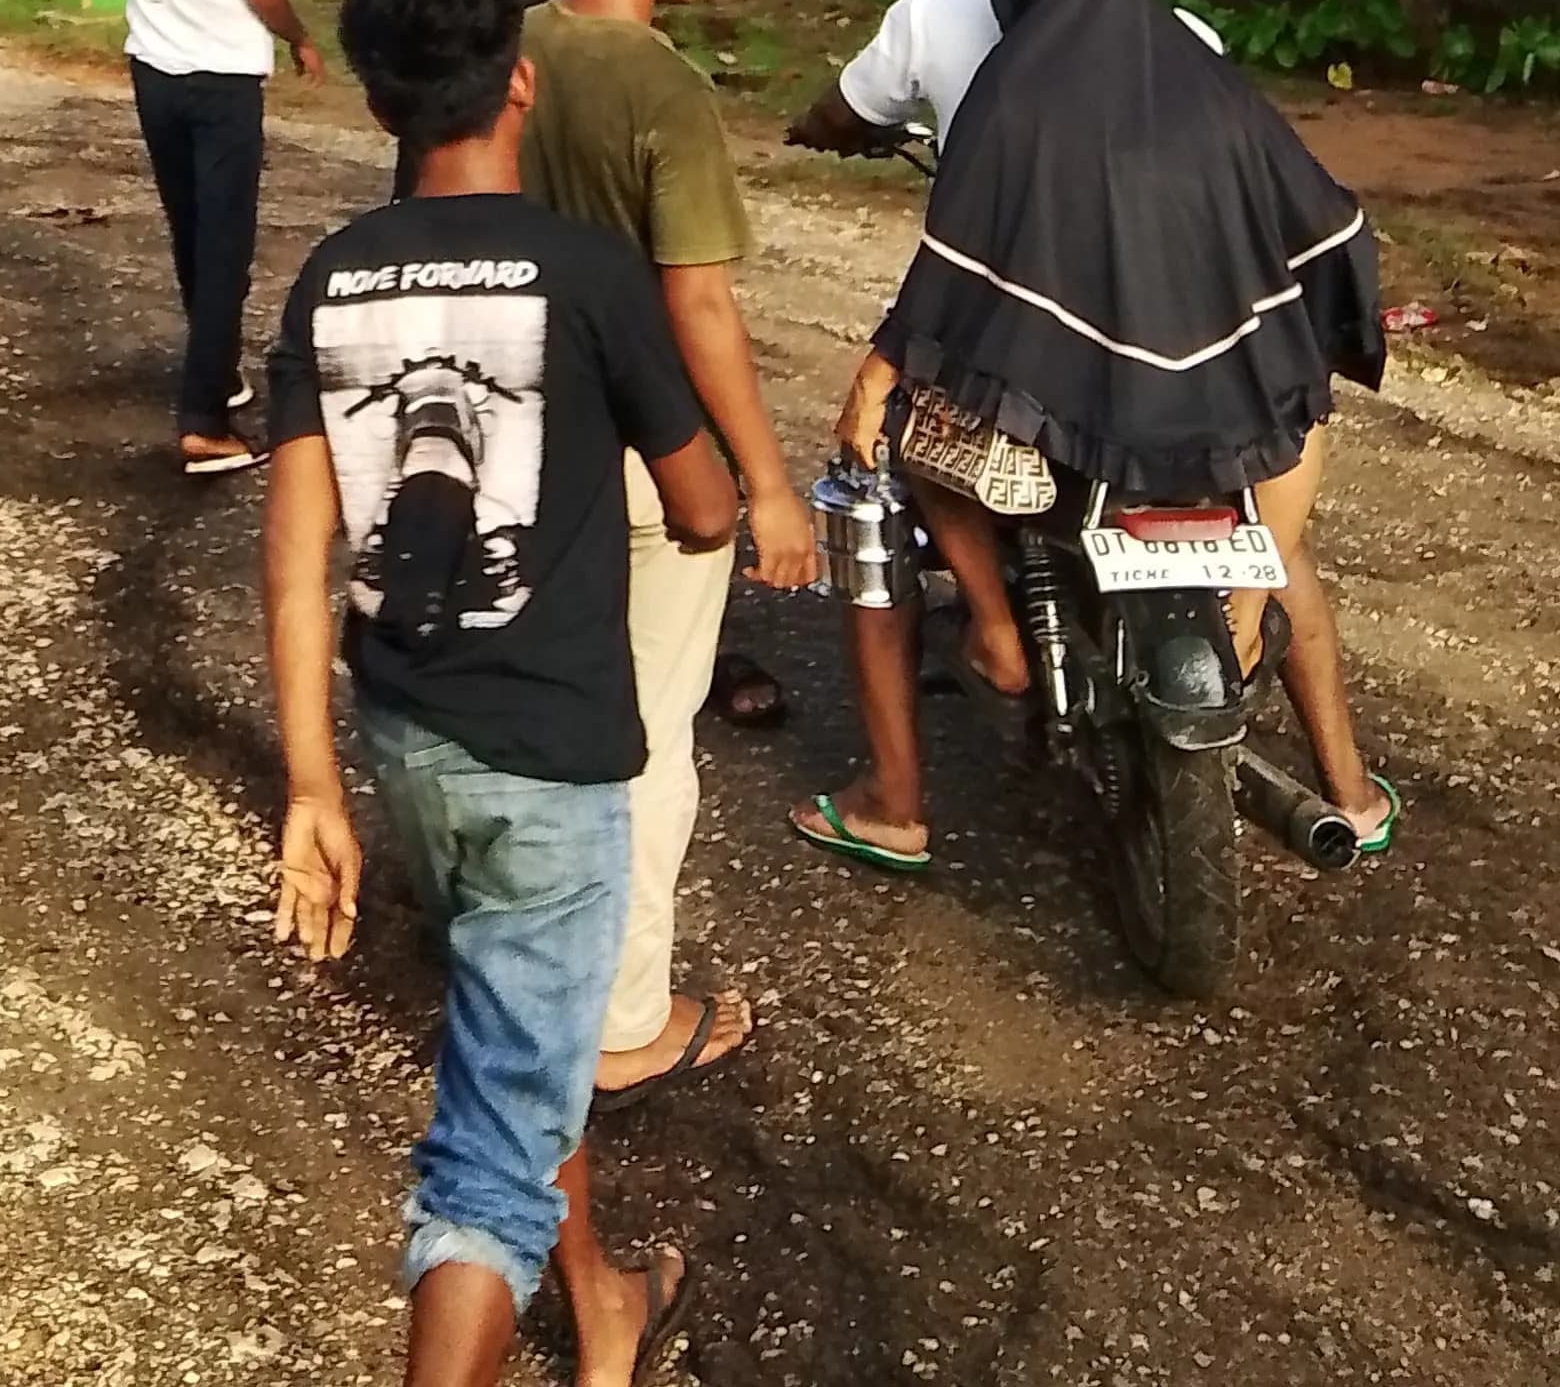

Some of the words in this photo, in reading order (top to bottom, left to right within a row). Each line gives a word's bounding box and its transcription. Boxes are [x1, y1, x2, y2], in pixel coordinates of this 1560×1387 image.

[399, 260, 539, 291] FORWARD
[1091, 532, 1126, 557] DT
[1229, 529, 1268, 554] ED
